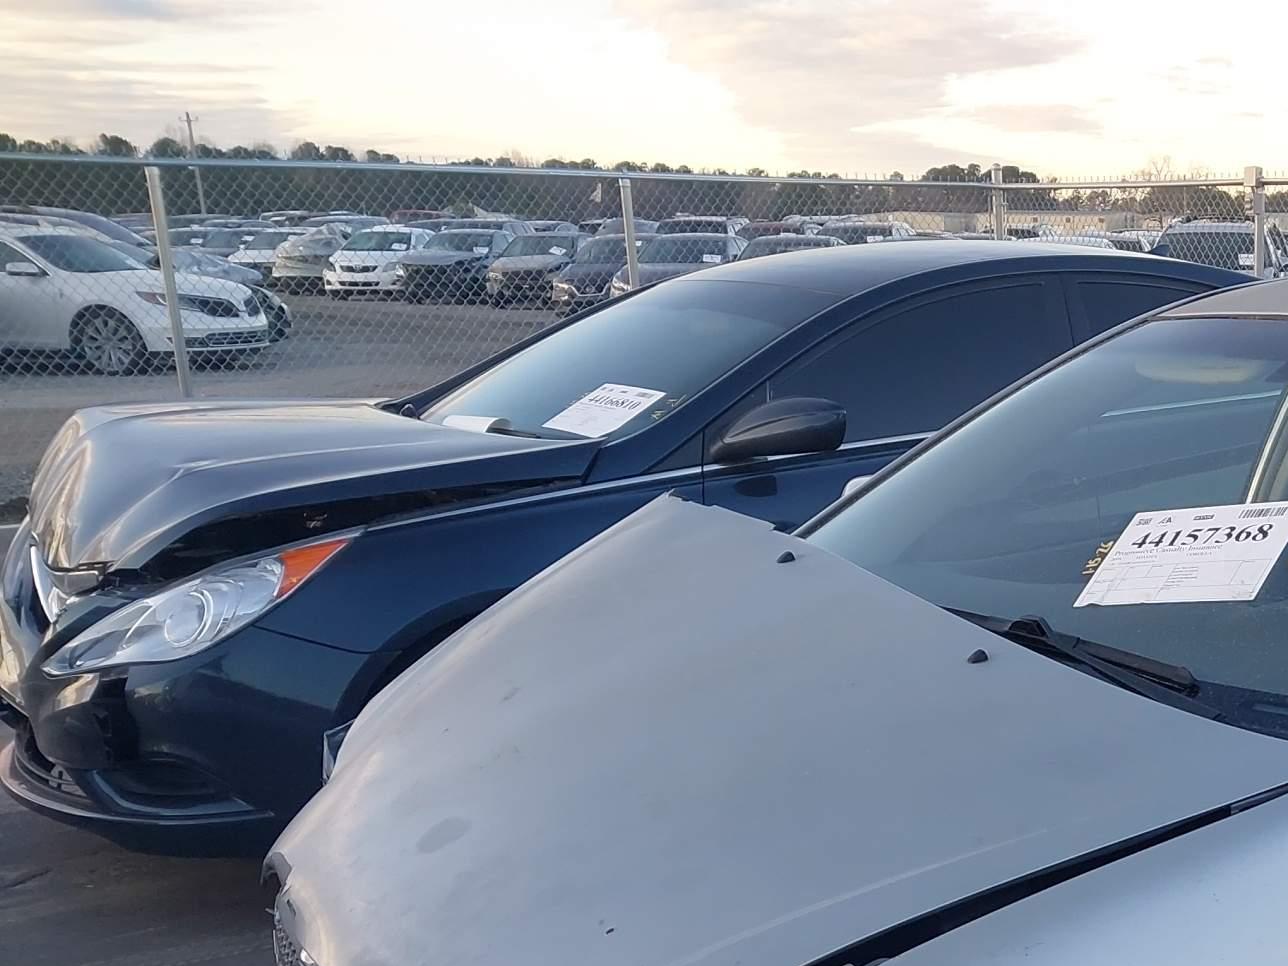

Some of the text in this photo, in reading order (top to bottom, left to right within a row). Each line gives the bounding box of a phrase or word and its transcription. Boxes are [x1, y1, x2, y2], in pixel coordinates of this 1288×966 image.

[588, 394, 642, 410] 44166810
[1132, 523, 1274, 548] 44157368
[1155, 545, 1187, 553] Casualty
